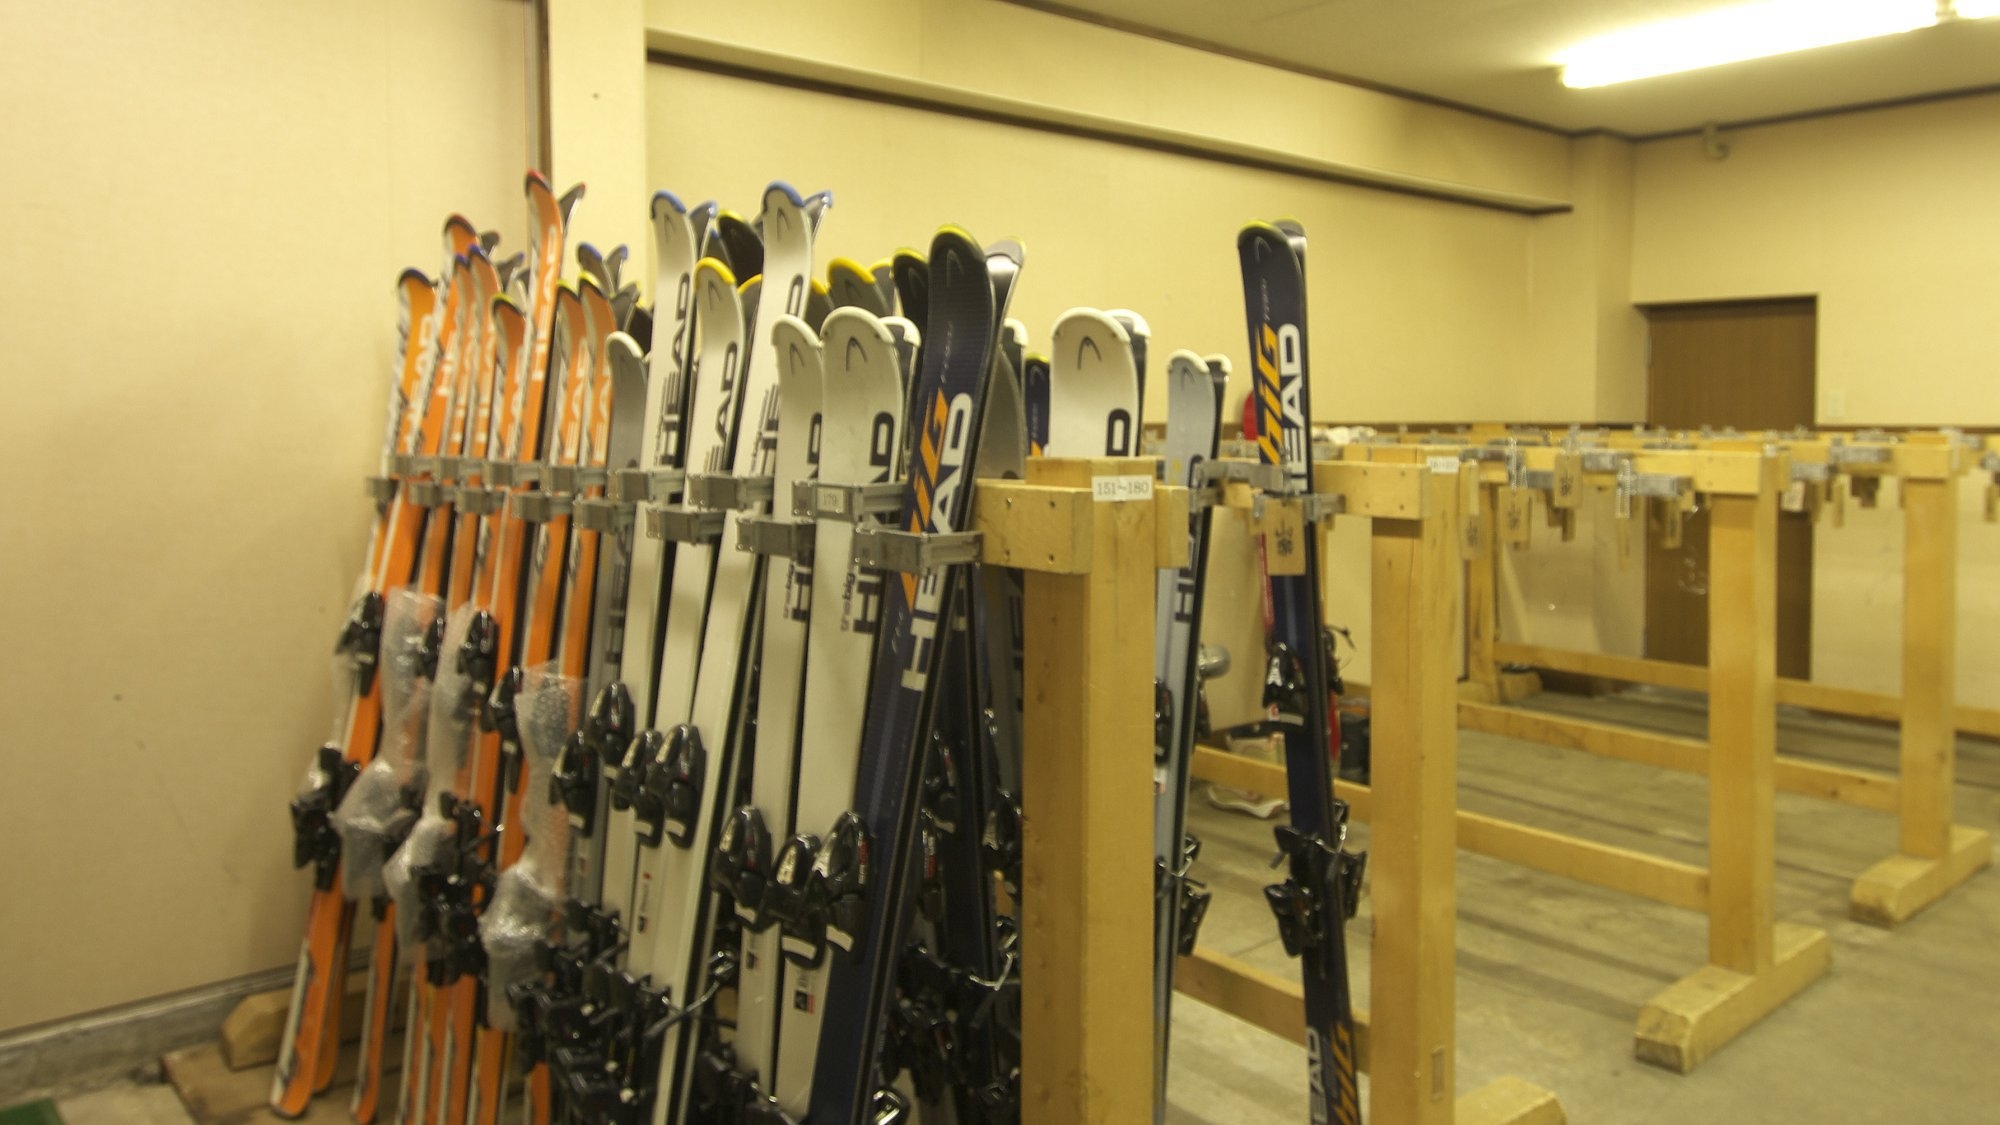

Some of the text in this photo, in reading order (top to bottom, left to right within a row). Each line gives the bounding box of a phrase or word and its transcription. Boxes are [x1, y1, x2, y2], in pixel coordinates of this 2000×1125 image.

[564, 337, 589, 458] EAD
[661, 273, 689, 466] HEAD
[707, 340, 738, 473] EAD
[760, 274, 804, 476] HED
[1279, 324, 1308, 491] EAD
